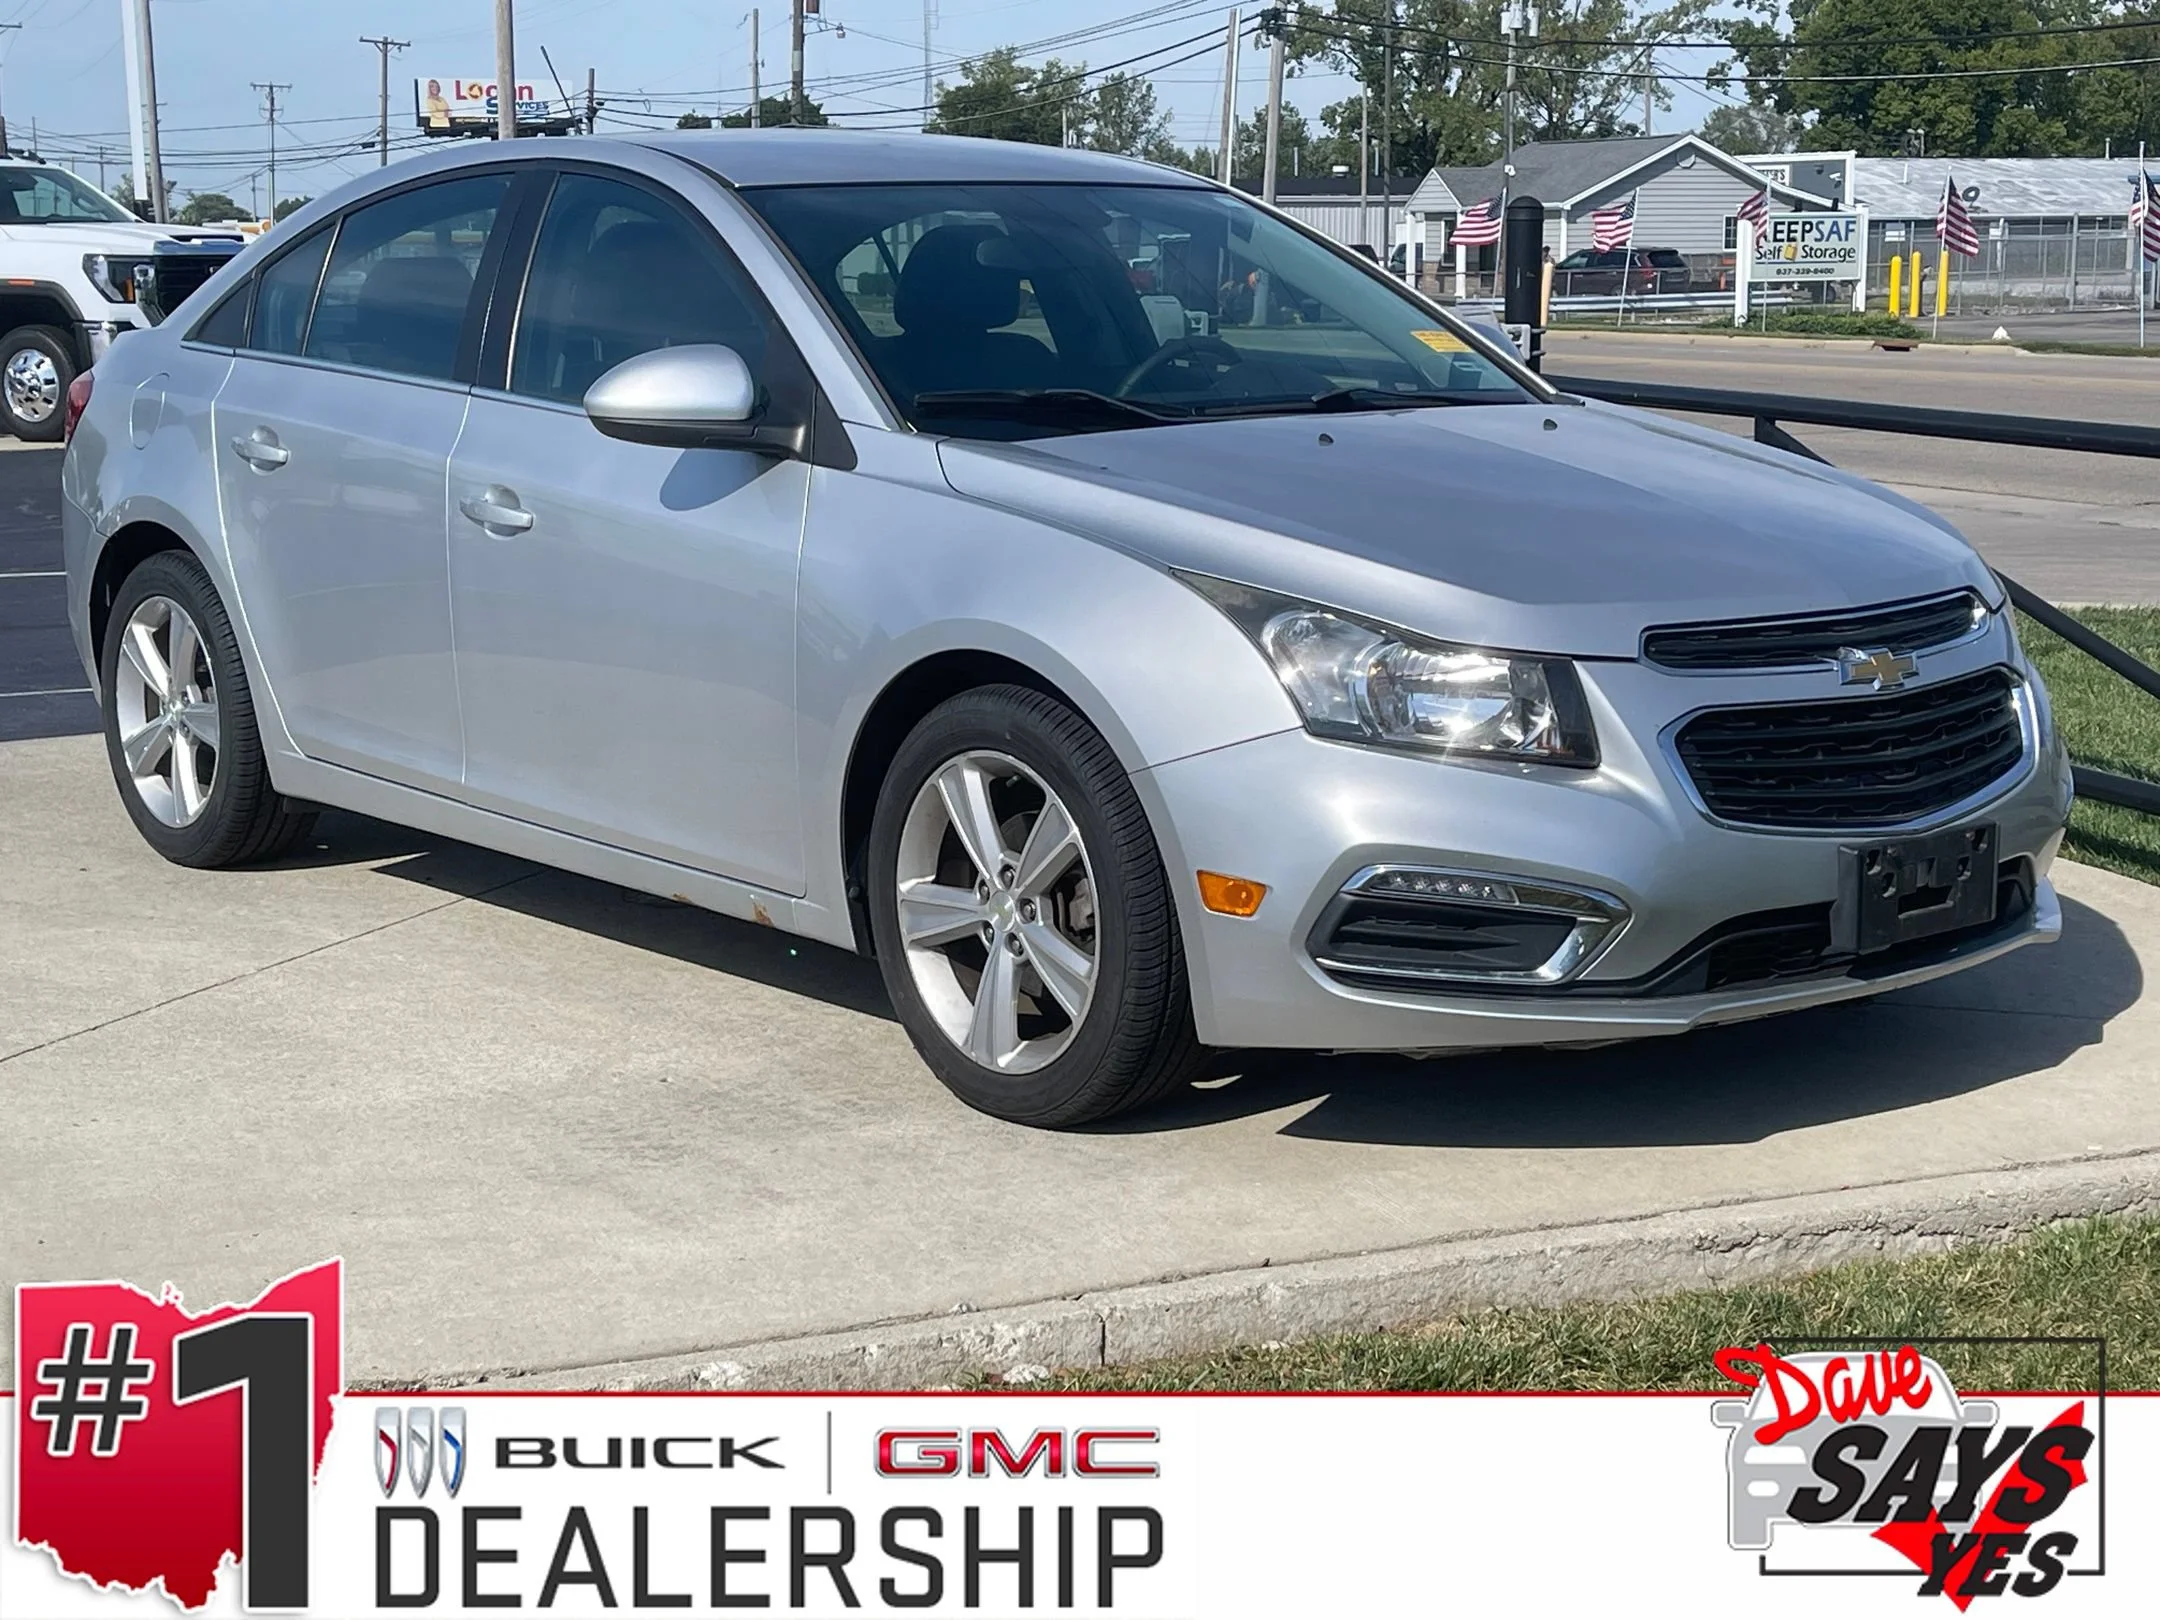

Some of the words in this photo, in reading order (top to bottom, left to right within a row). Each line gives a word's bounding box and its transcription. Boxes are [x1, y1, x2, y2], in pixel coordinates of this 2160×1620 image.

[455, 80, 533, 100] Logn
[486, 97, 549, 114] SVICES
[1763, 220, 1857, 242] EEPSAF
[1755, 245, 1783, 260] Self
[1801, 244, 1856, 262] Storage
